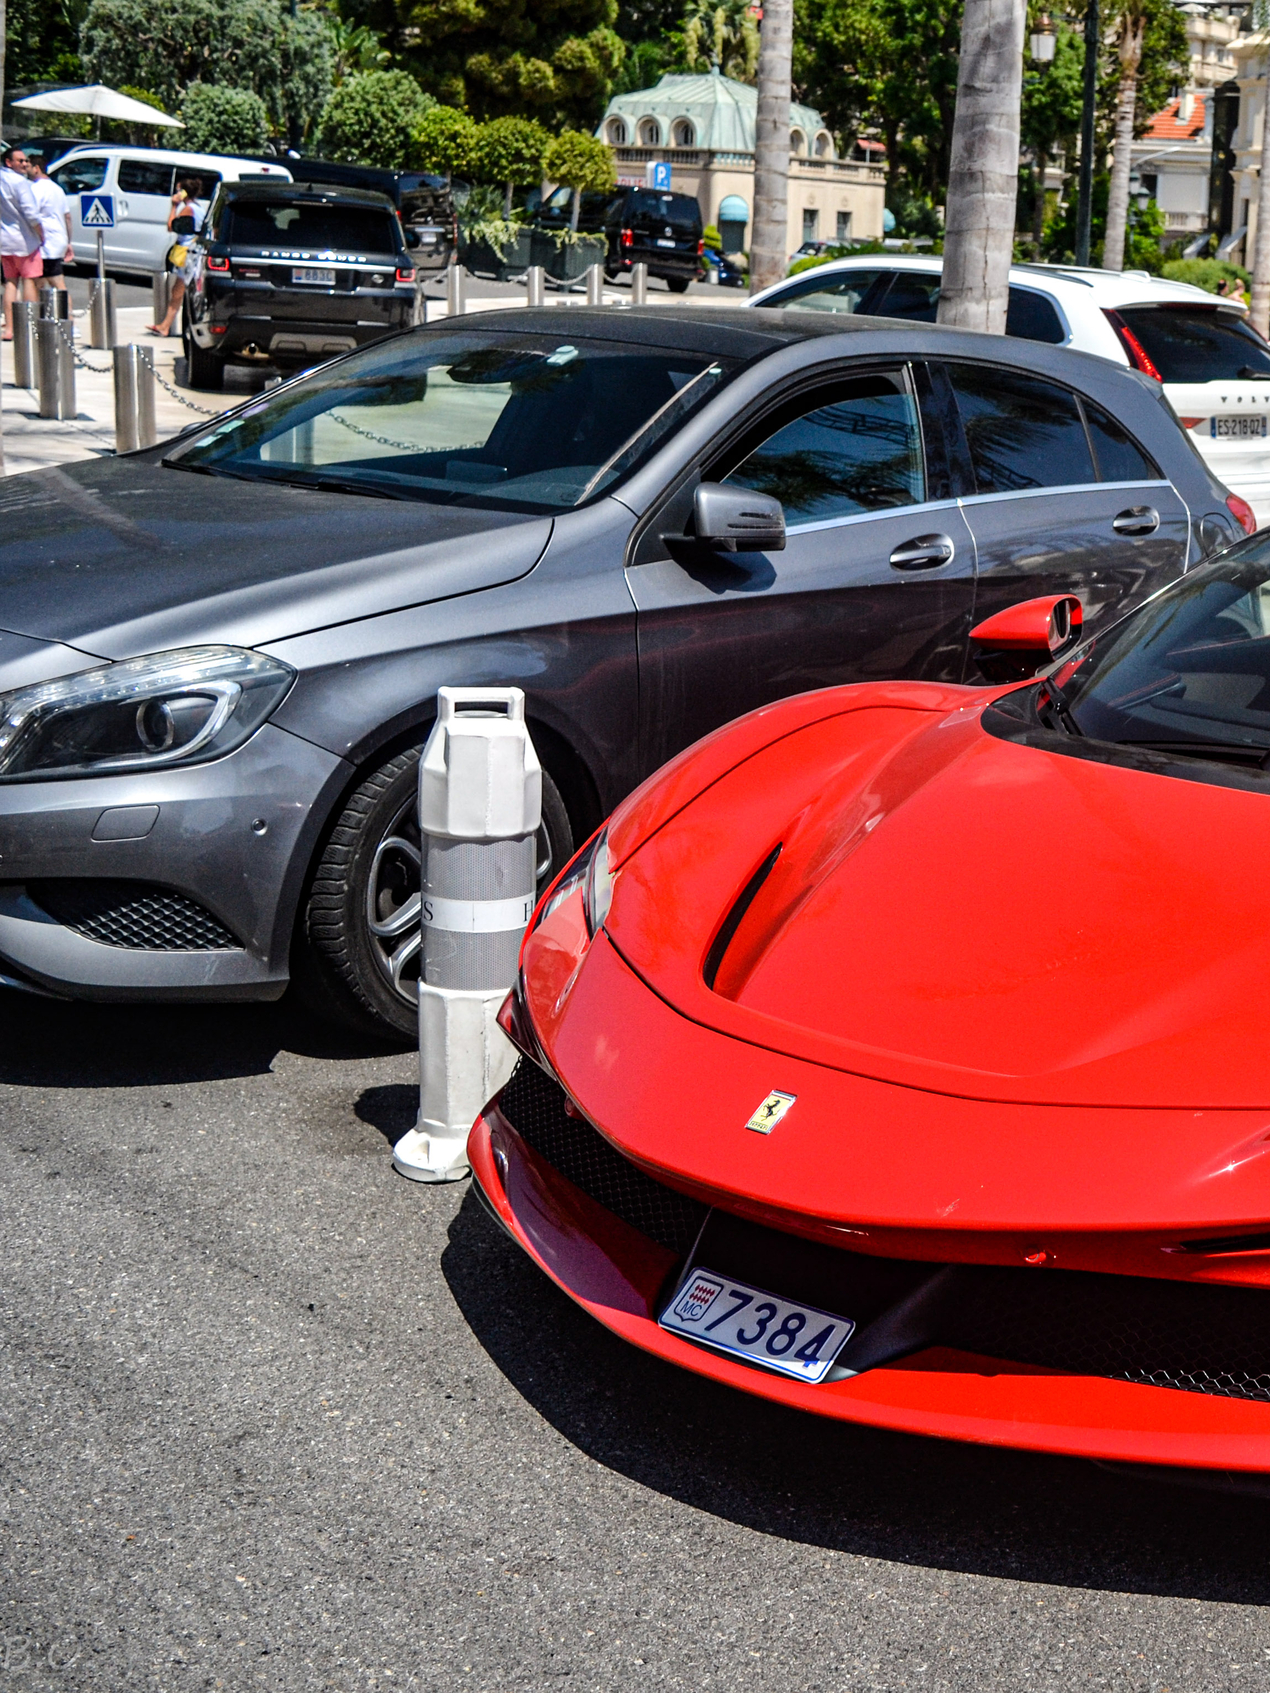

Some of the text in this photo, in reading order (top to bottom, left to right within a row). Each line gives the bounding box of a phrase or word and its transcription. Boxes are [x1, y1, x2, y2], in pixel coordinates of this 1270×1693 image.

[657, 166, 667, 183] P
[680, 1300, 703, 1317] MC
[703, 1289, 836, 1369] 7384
